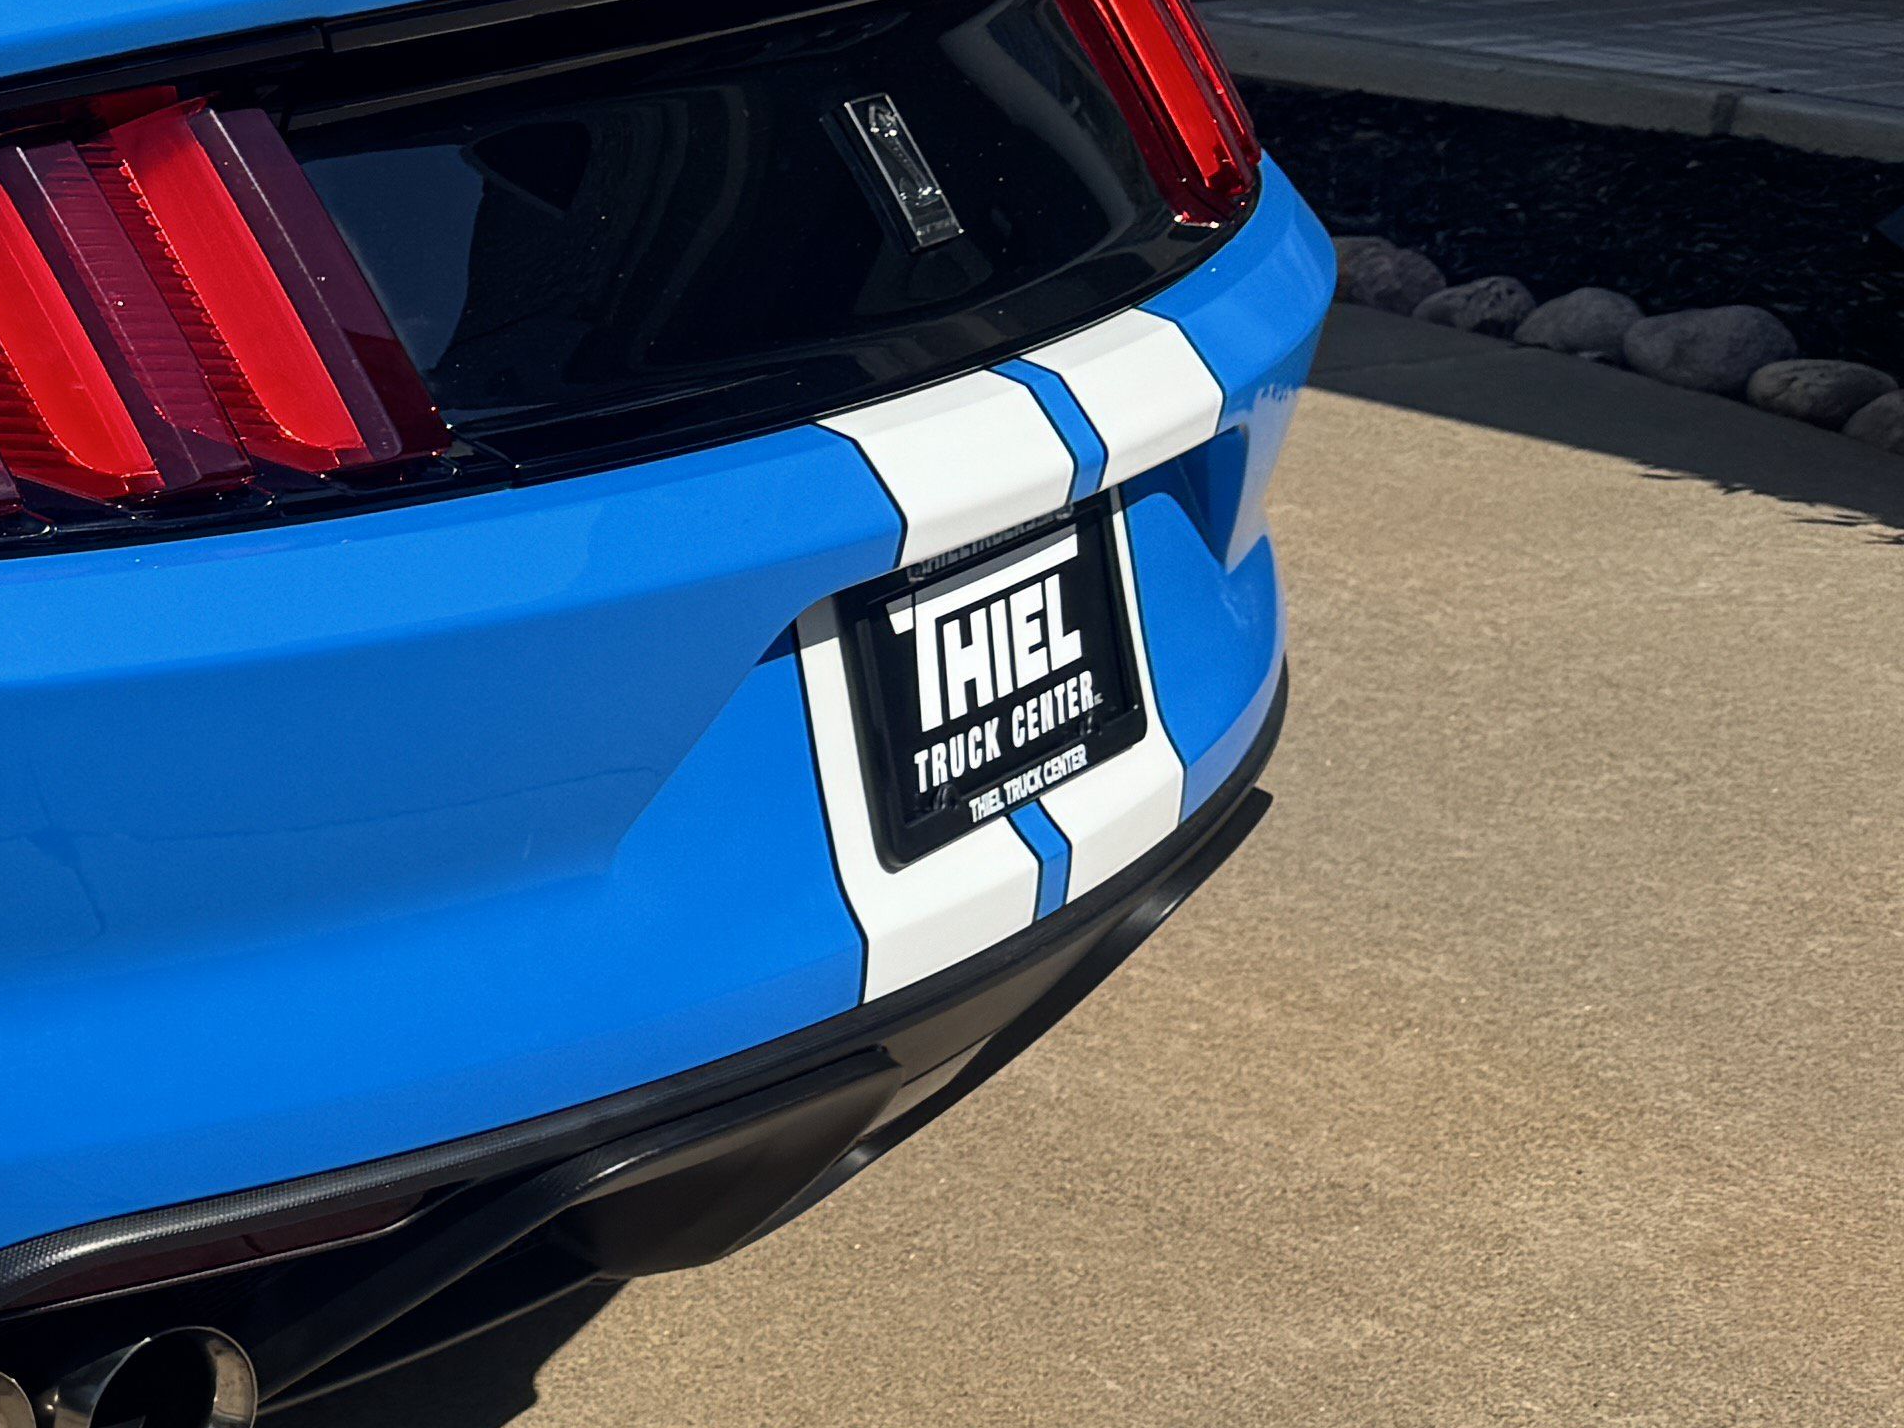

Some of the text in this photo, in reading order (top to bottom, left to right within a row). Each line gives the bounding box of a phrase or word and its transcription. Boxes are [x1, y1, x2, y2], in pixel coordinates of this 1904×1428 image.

[886, 524, 1082, 733] THIEL
[914, 670, 1094, 794] TRUCK CENTER
[969, 744, 1088, 823] THIEL TRUCK CENTER
